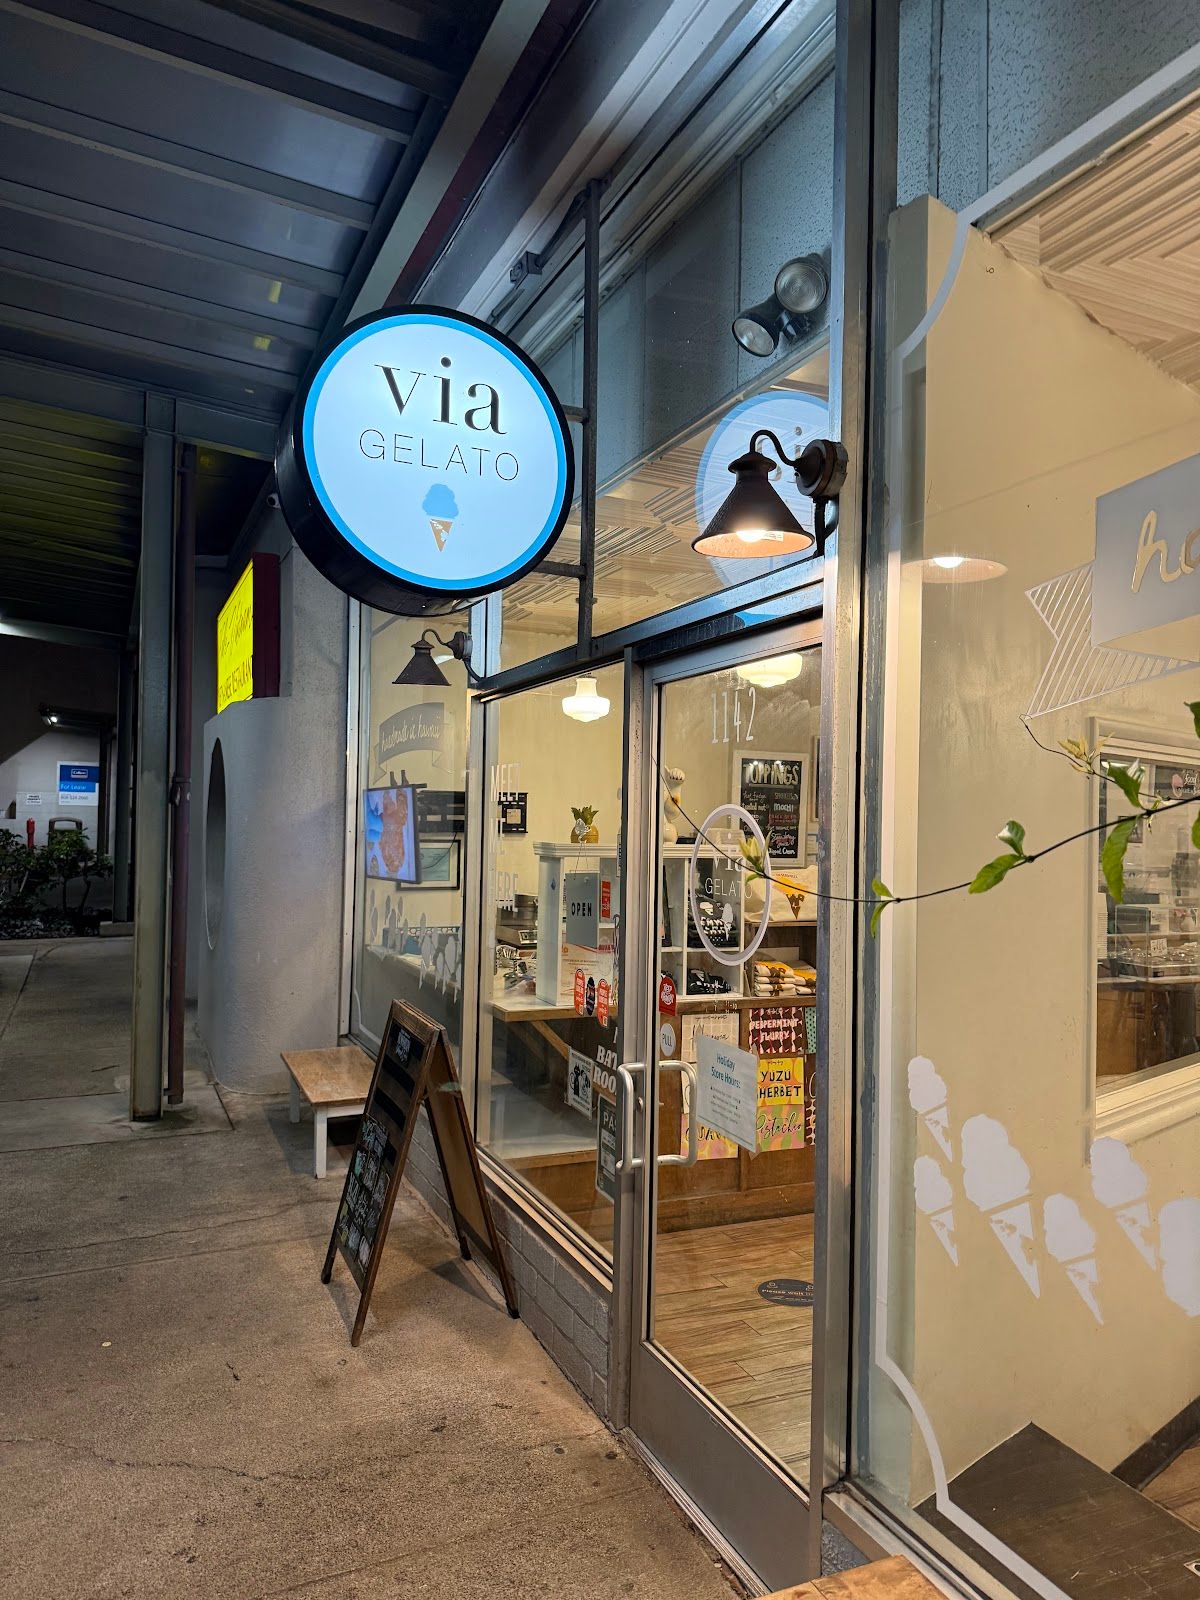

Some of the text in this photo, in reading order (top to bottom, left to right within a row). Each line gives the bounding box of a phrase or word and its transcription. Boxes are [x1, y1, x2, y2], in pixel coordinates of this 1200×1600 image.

[374, 356, 508, 435] via
[359, 428, 519, 481] GELATO
[711, 687, 756, 743] 1142
[743, 762, 799, 785] TOPPINGS
[705, 877, 753, 899] GELATO
[571, 902, 592, 917] OPEN
[750, 1018, 799, 1030] PEPPERMINT
[760, 1030, 789, 1041] FLURRY
[716, 1053, 736, 1073] Holiday
[593, 1065, 617, 1096] ROO
[761, 1070, 791, 1083] YUZU
[757, 1085, 802, 1099] HERBET
